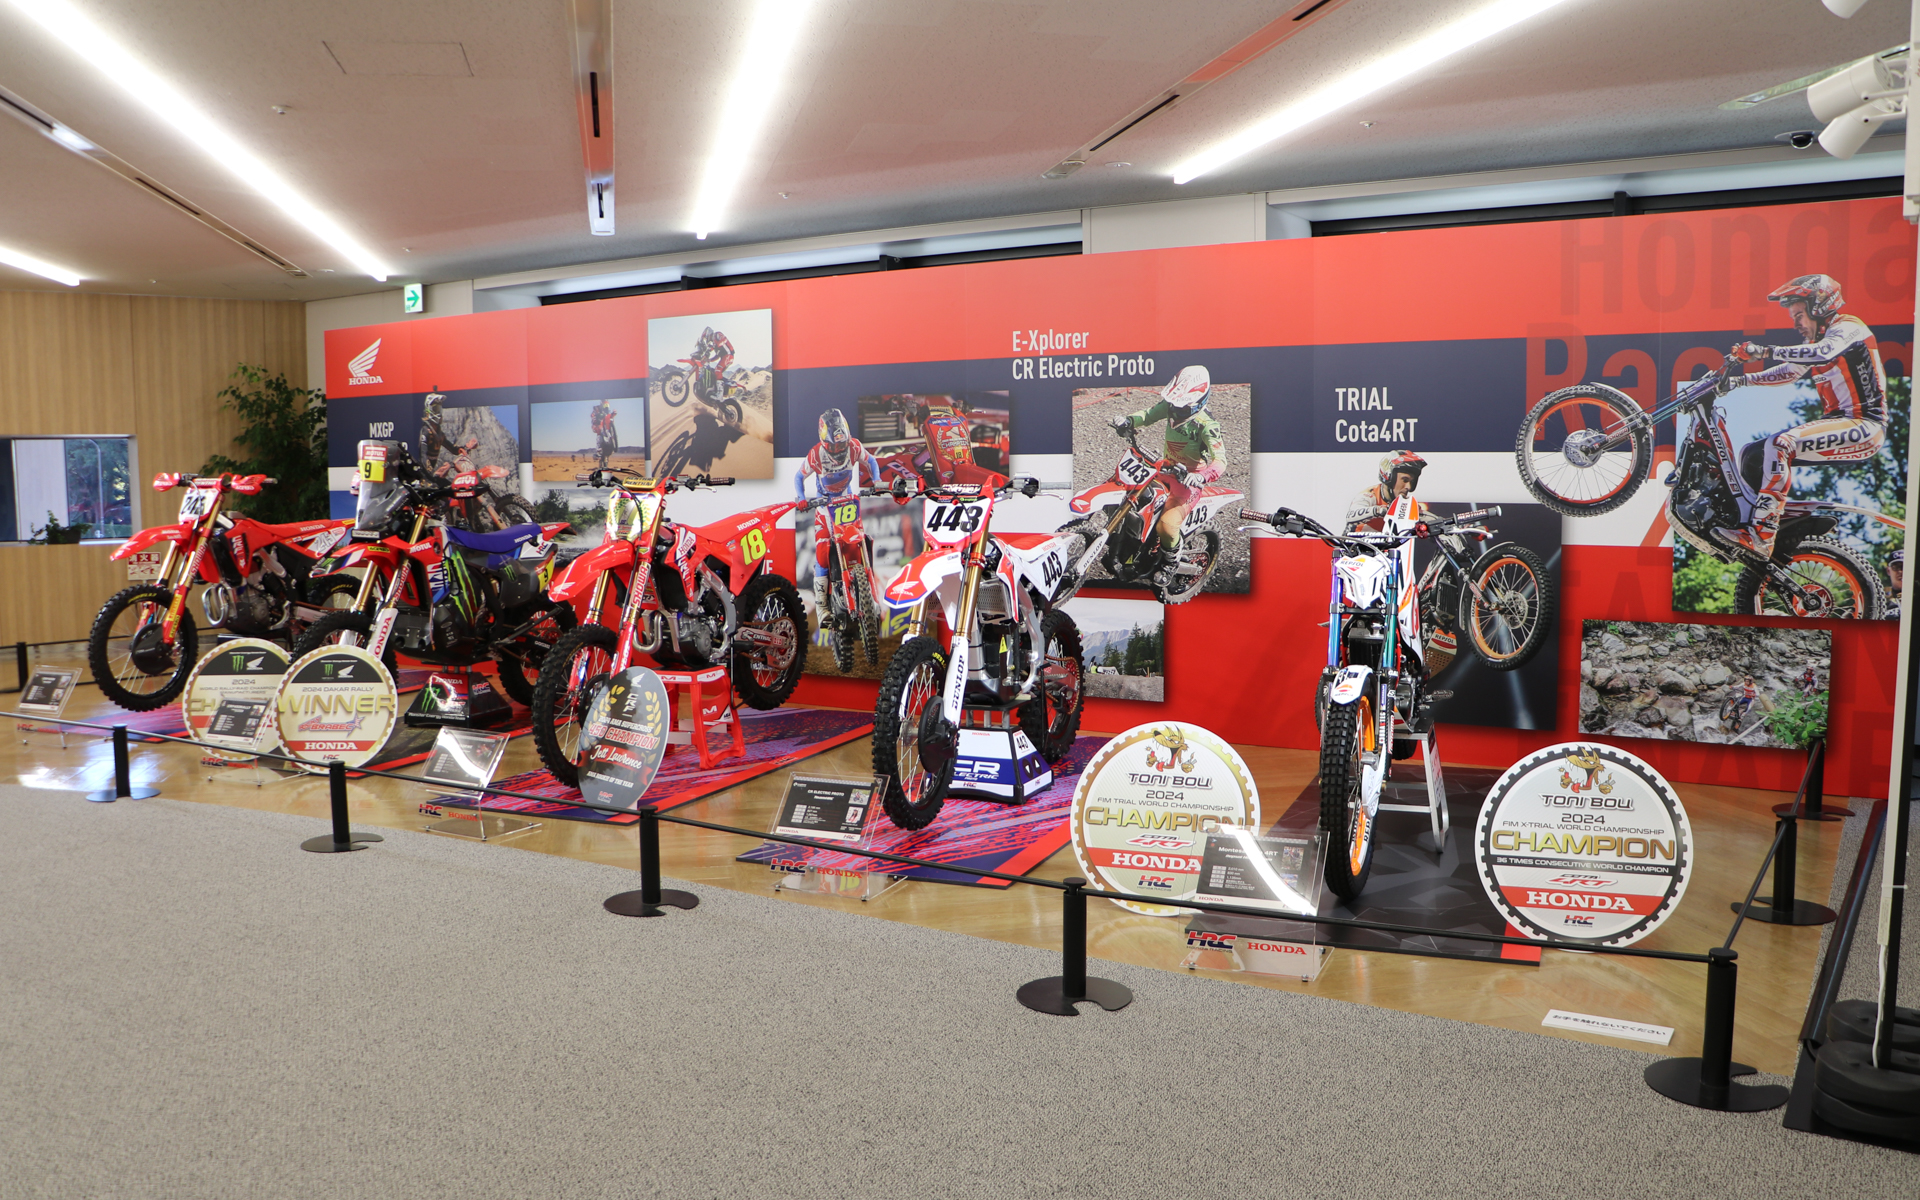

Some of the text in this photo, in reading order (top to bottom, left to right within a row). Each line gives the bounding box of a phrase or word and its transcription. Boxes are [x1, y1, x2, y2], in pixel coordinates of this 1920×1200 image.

[1012, 329, 1089, 355] E-Xplorer
[1775, 344, 1835, 359] REPSOL
[1012, 354, 1154, 379] CR Electric Proto
[349, 376, 383, 386] HONDA
[1335, 387, 1393, 411] TRIAL
[369, 422, 394, 438] MXGP
[1335, 418, 1418, 443] Cota4RT
[1801, 424, 1871, 452] REPSOL
[1710, 427, 1728, 461] REPSOL
[364, 462, 372, 478] 9
[1119, 457, 1151, 484] 443
[834, 504, 857, 525] 18
[926, 505, 983, 532] 443
[1185, 505, 1207, 528] 443
[1346, 506, 1370, 519] EPSOL
[1457, 511, 1487, 520] RENTHAL
[737, 517, 761, 531] HONDA
[409, 542, 432, 554] MOTUL
[679, 536, 695, 555] HONDA
[740, 528, 767, 566] 18
[1082, 540, 1103, 569] DUNLOP
[1041, 551, 1063, 589] 443
[1340, 560, 1364, 568] REPSOL
[632, 565, 649, 608] SHOWA
[374, 616, 393, 658] ONDA
[1435, 634, 1454, 644] REPSOL
[951, 655, 965, 711] DUNLOP
[277, 694, 395, 715] WINNER
[310, 723, 353, 731] BRABEC
[598, 716, 654, 733] 2024 AMA SUPERCROSS
[588, 724, 659, 750] 450 CHAMPION
[1016, 735, 1029, 750] 443
[304, 742, 358, 750] HONDA
[590, 745, 642, 770] Jett Lawrence
[956, 759, 1000, 774] CR
[614, 777, 622, 785] THE
[622, 779, 634, 788] YEAR
[953, 771, 999, 780] LECTRIC
[1128, 773, 1171, 786] TONI
[1146, 789, 1184, 801] 2024
[1541, 795, 1583, 807] TONI
[419, 803, 443, 815] HRC
[1113, 798, 1136, 806] TRIAL
[1138, 799, 1169, 808] WORLD
[1170, 801, 1234, 812] CHAMPIONSHIP
[448, 811, 478, 822] HONDA
[1084, 806, 1244, 834] CHAMPION
[1561, 813, 1606, 825] 2024
[1521, 821, 1554, 830] X-TRIAL
[1557, 824, 1591, 832] WORLD
[1593, 825, 1665, 835] CHAMPIONSHIP
[1492, 830, 1675, 860] CHAMPION
[770, 858, 807, 873] HRC
[1112, 852, 1203, 872] HONDA
[1509, 857, 1534, 865] TIMES
[1535, 859, 1591, 869] CONSECUTIVE
[1593, 862, 1623, 871] WORLD
[1624, 864, 1669, 873] CHAMPION
[816, 867, 862, 879] HONDA
[1138, 875, 1175, 888] HRC
[1526, 890, 1634, 911] HONDA
[1563, 915, 1595, 925] HRC
[1187, 931, 1237, 949] HRC
[1247, 942, 1307, 955] HONDA
[1552, 1014, 1667, 1036] お手を触れないでください
